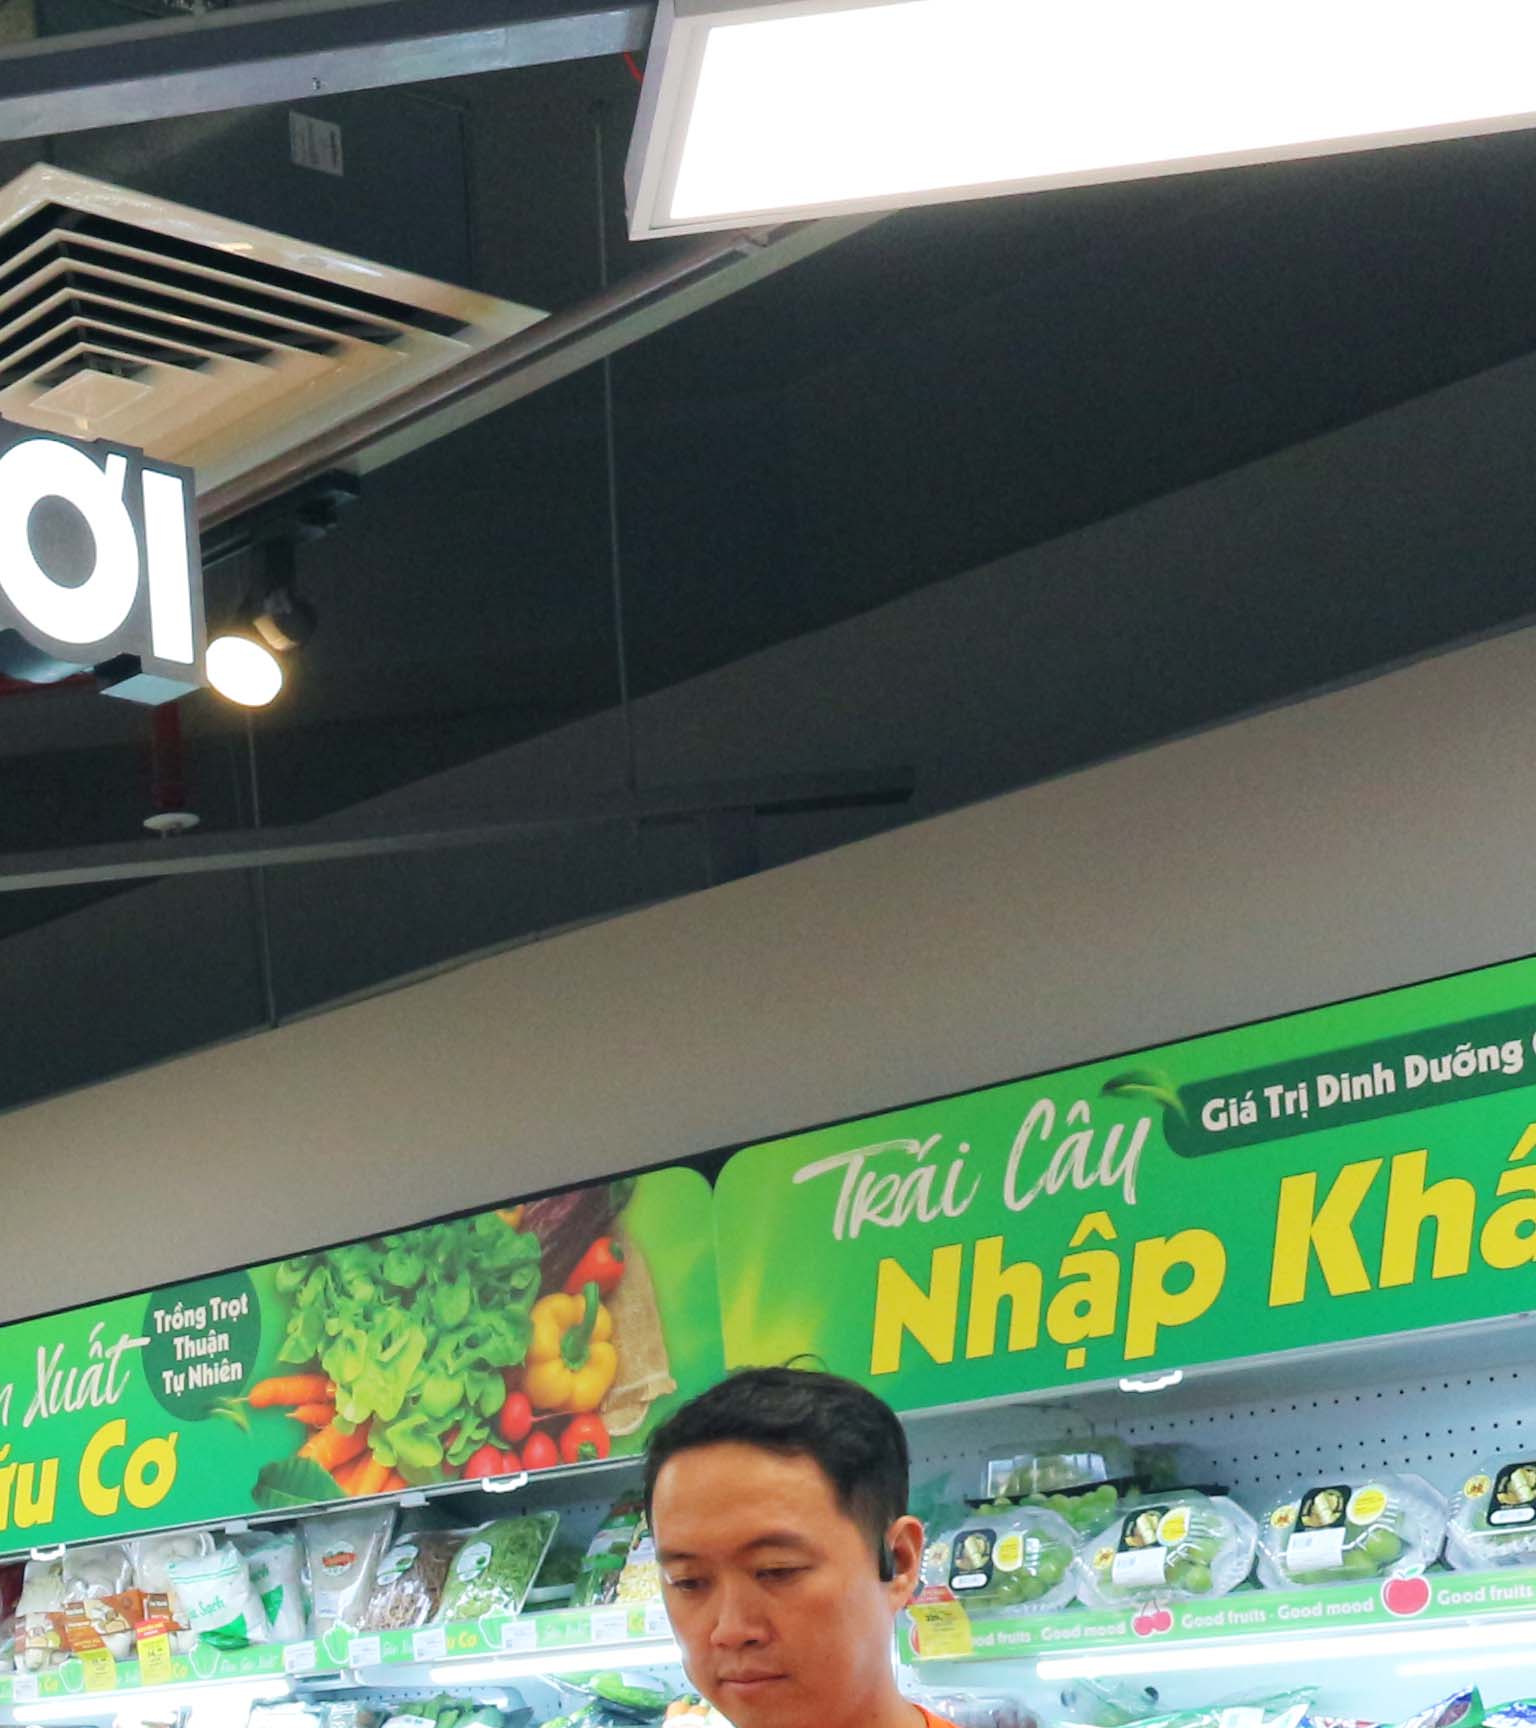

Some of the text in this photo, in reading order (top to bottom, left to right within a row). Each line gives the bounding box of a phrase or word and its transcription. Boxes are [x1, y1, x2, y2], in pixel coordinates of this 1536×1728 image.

[1200, 1040, 1525, 1133] Giá Trị Dinh Dưỡng
[792, 1098, 1151, 1241] Trái Cây
[870, 1123, 1536, 1376] Nhập Kh
[153, 1293, 248, 1334] Trồng Trọt
[173, 1331, 229, 1362] Thuận
[24, 1321, 151, 1430] Xuất
[161, 1361, 243, 1397] Tự Nhiên
[78, 1418, 179, 1517] Cơ
[1041, 1623, 1081, 1641] Good
[1085, 1620, 1125, 1636] mood
[1182, 1611, 1225, 1629] Good
[1228, 1607, 1266, 1625] fruits
[1278, 1603, 1321, 1620] Good
[1325, 1598, 1374, 1615] mood
[1437, 1587, 1486, 1605] Good
[1491, 1583, 1535, 1602] fruits
